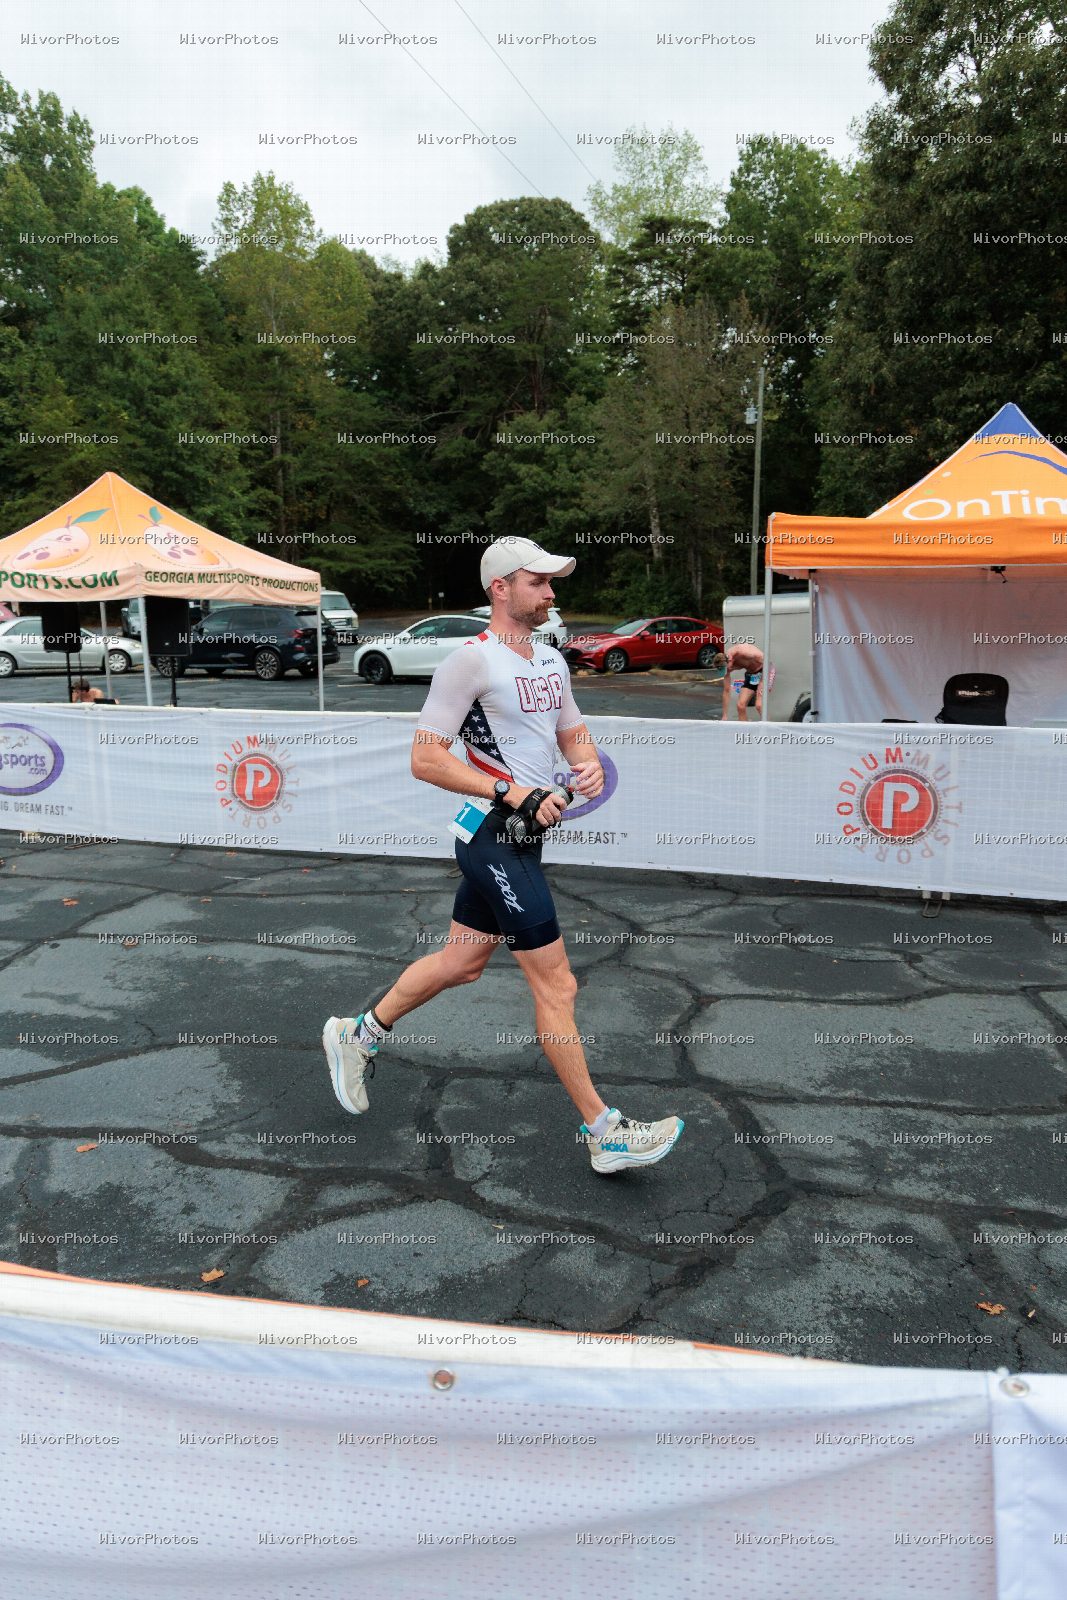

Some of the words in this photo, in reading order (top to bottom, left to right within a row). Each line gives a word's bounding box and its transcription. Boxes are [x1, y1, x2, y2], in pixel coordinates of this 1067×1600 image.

[145, 571, 194, 584] GEORGIA
[198, 572, 260, 587] MULTISPORTS
[262, 577, 319, 592] PRODUCTIONS
[514, 672, 564, 713] USA
[836, 747, 904, 837] PODIUM
[881, 782, 920, 829] P
[14, 802, 42, 814] DREAM
[601, 1143, 629, 1153] HOKA
